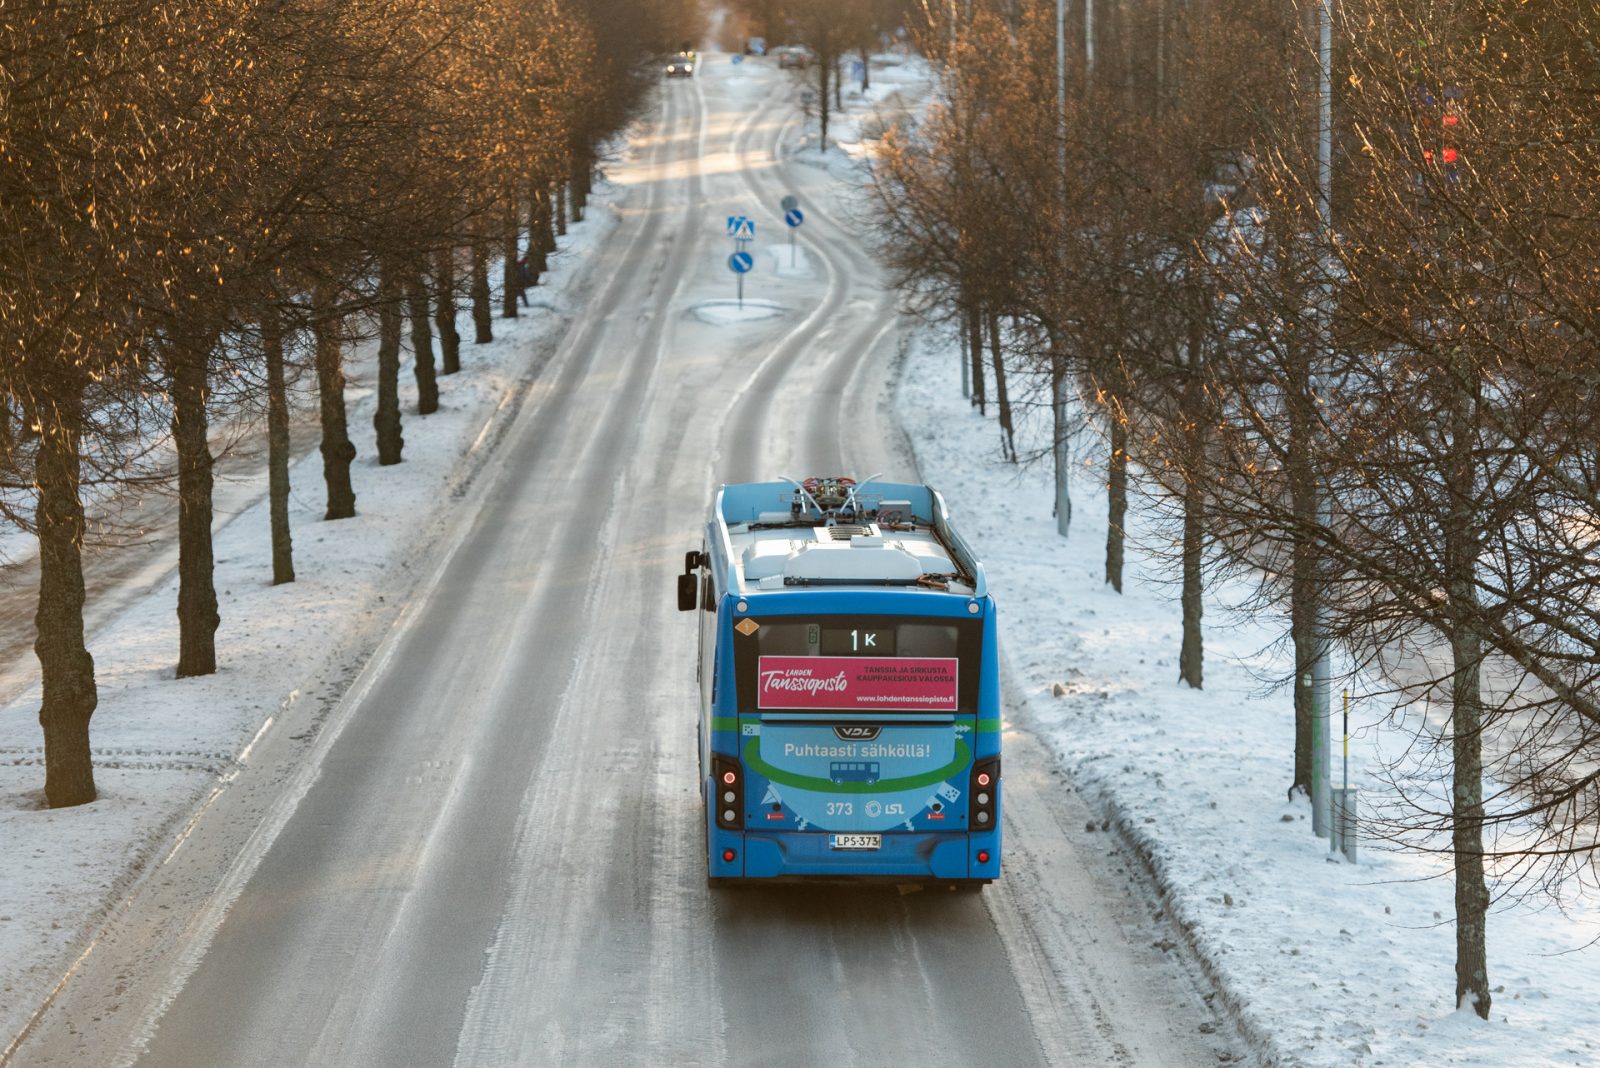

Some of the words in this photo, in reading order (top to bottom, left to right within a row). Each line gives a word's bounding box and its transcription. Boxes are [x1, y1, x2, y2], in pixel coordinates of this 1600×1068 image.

[851, 629, 858, 651] 1
[865, 633, 876, 646] K
[785, 669, 812, 677] LAHDEN
[761, 670, 847, 696] Tanssiopisto
[856, 696, 954, 704] www.lahdentanssiopisto.fi
[842, 728, 872, 736] VDL
[784, 743, 857, 757] Puhtaasti
[861, 744, 930, 757] sähköllä!
[826, 802, 853, 815] 373
[837, 837, 879, 846] LPS-373
